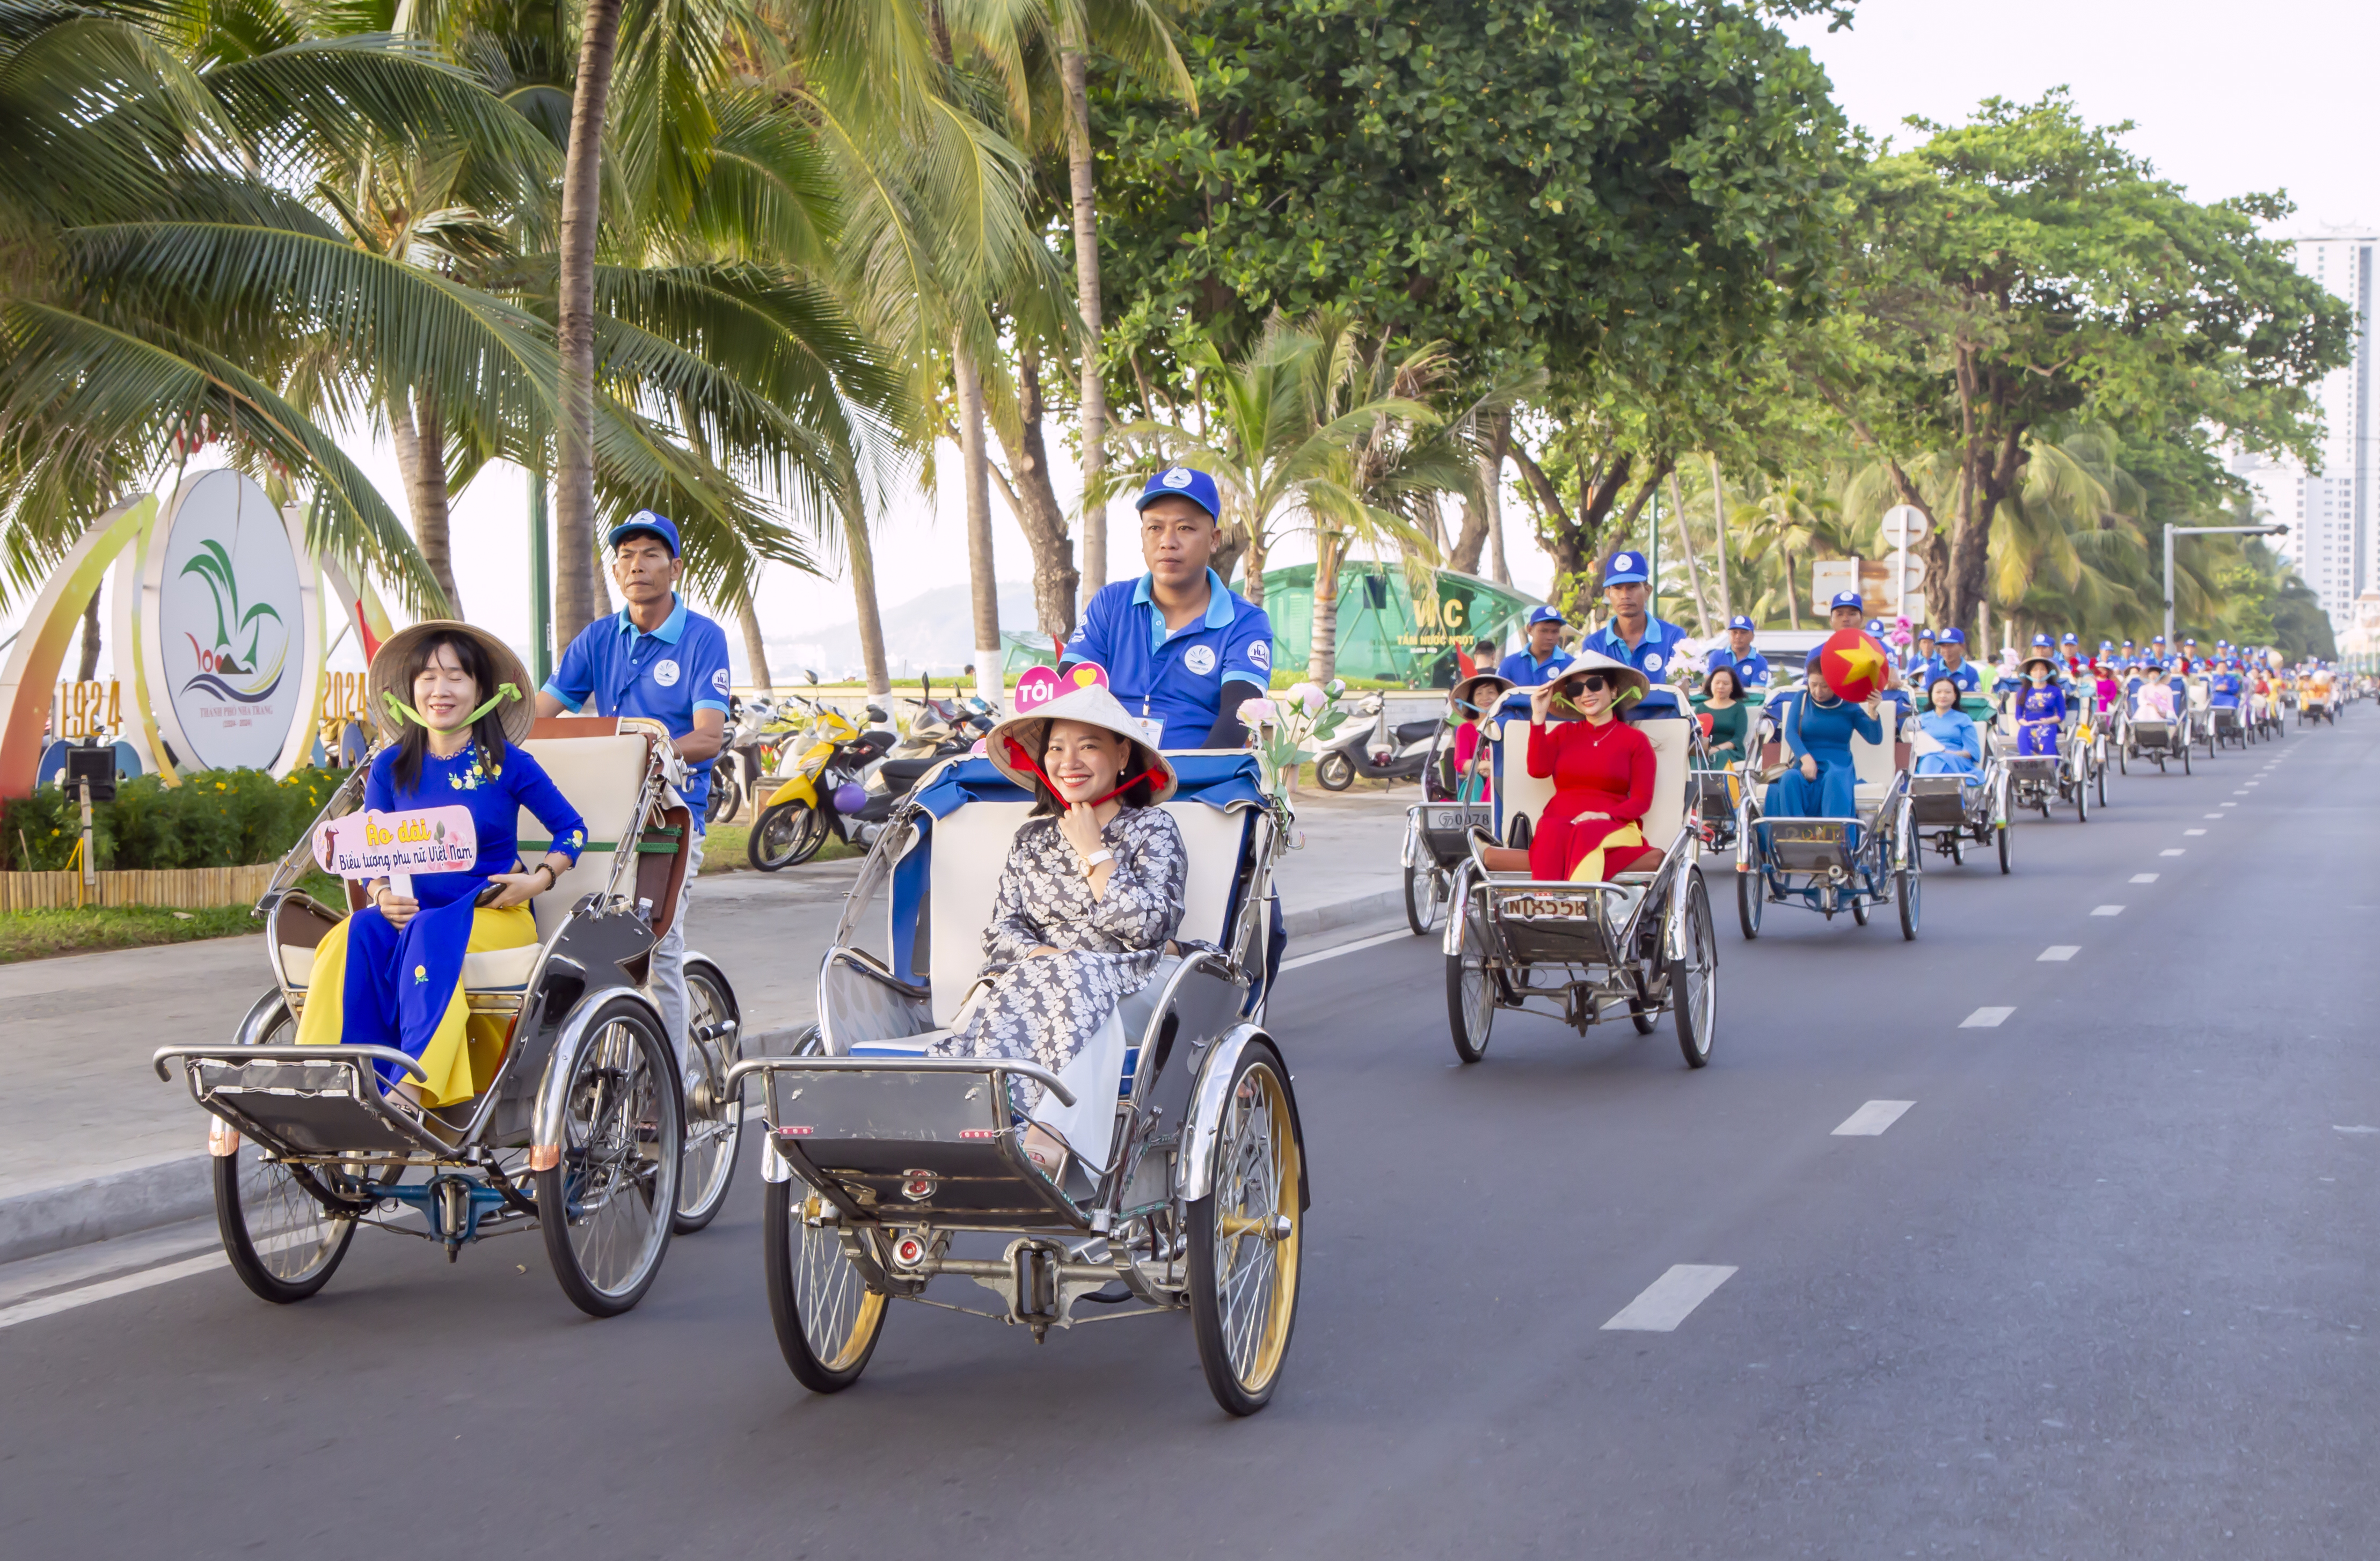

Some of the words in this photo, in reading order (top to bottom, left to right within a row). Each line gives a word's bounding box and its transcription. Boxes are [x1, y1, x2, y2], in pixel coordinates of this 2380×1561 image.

[1413, 599, 1463, 628] WC
[323, 671, 367, 721] 2024
[1019, 680, 1053, 702] TÔI
[62, 681, 120, 739] 1924
[366, 815, 393, 847] Áo
[397, 818, 431, 843] dài
[339, 850, 360, 871] Biểu
[393, 850, 411, 869] phụ
[413, 848, 427, 863] nữ
[428, 845, 448, 866] Việt
[450, 844, 472, 860] Nam
